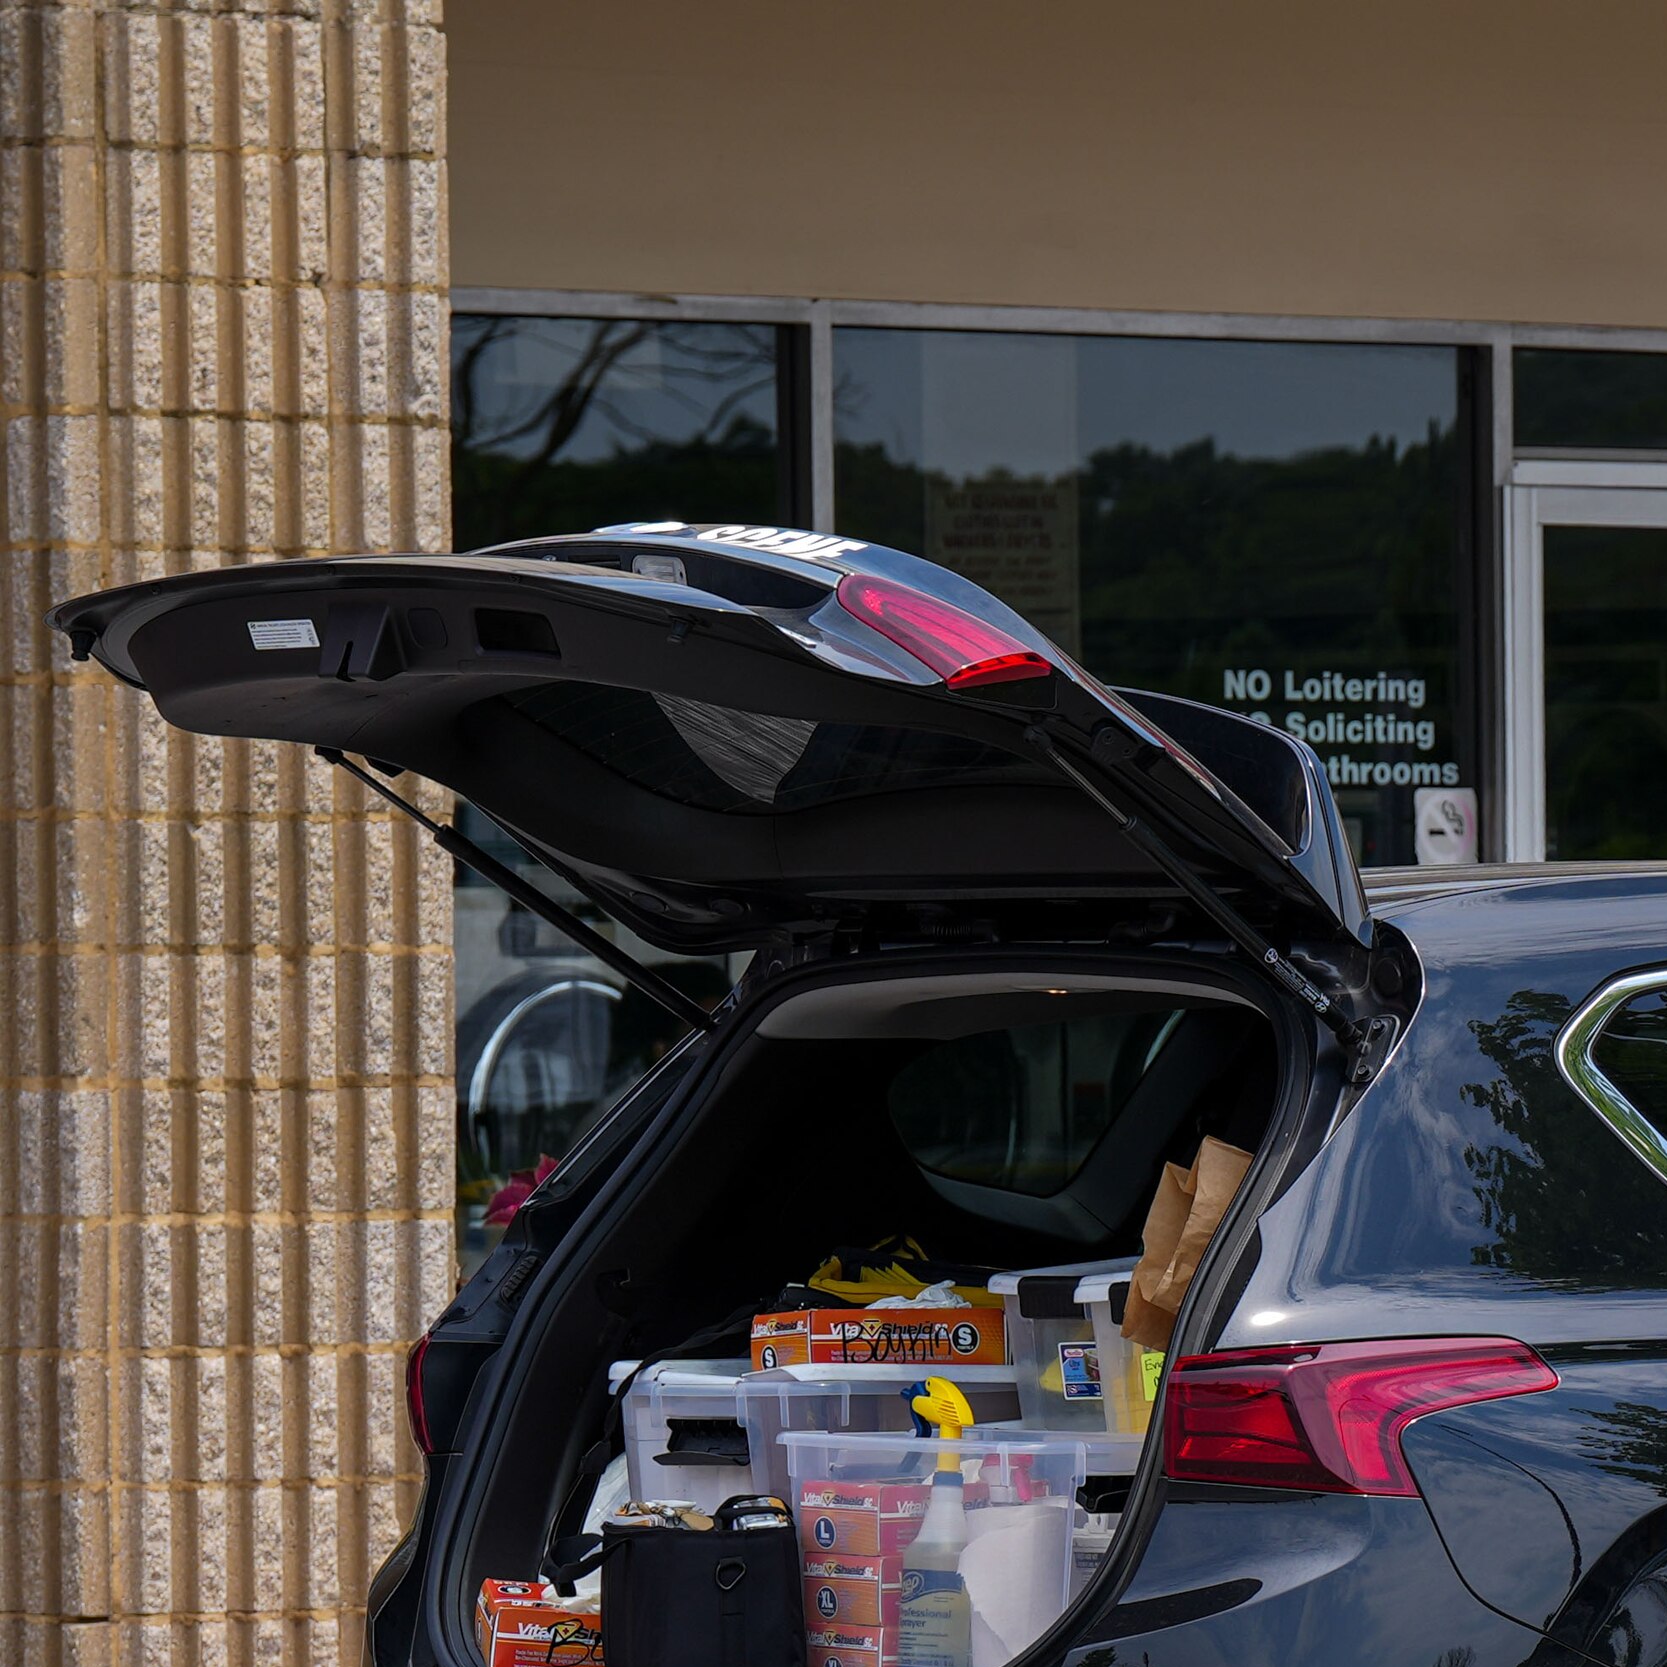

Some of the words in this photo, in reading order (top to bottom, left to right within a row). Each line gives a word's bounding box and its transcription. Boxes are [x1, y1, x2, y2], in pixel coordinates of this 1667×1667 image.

[1224, 670, 1271, 700] NO
[1285, 670, 1425, 708] Loitering
[1286, 711, 1435, 750] Soliciting
[1326, 755, 1459, 785] throoms
[881, 1322, 933, 1335] Shield
[957, 1326, 973, 1346] S
[764, 1347, 774, 1365] S
[832, 1495, 864, 1506] Shield
[820, 1520, 831, 1539] L
[821, 1590, 834, 1608] XL
